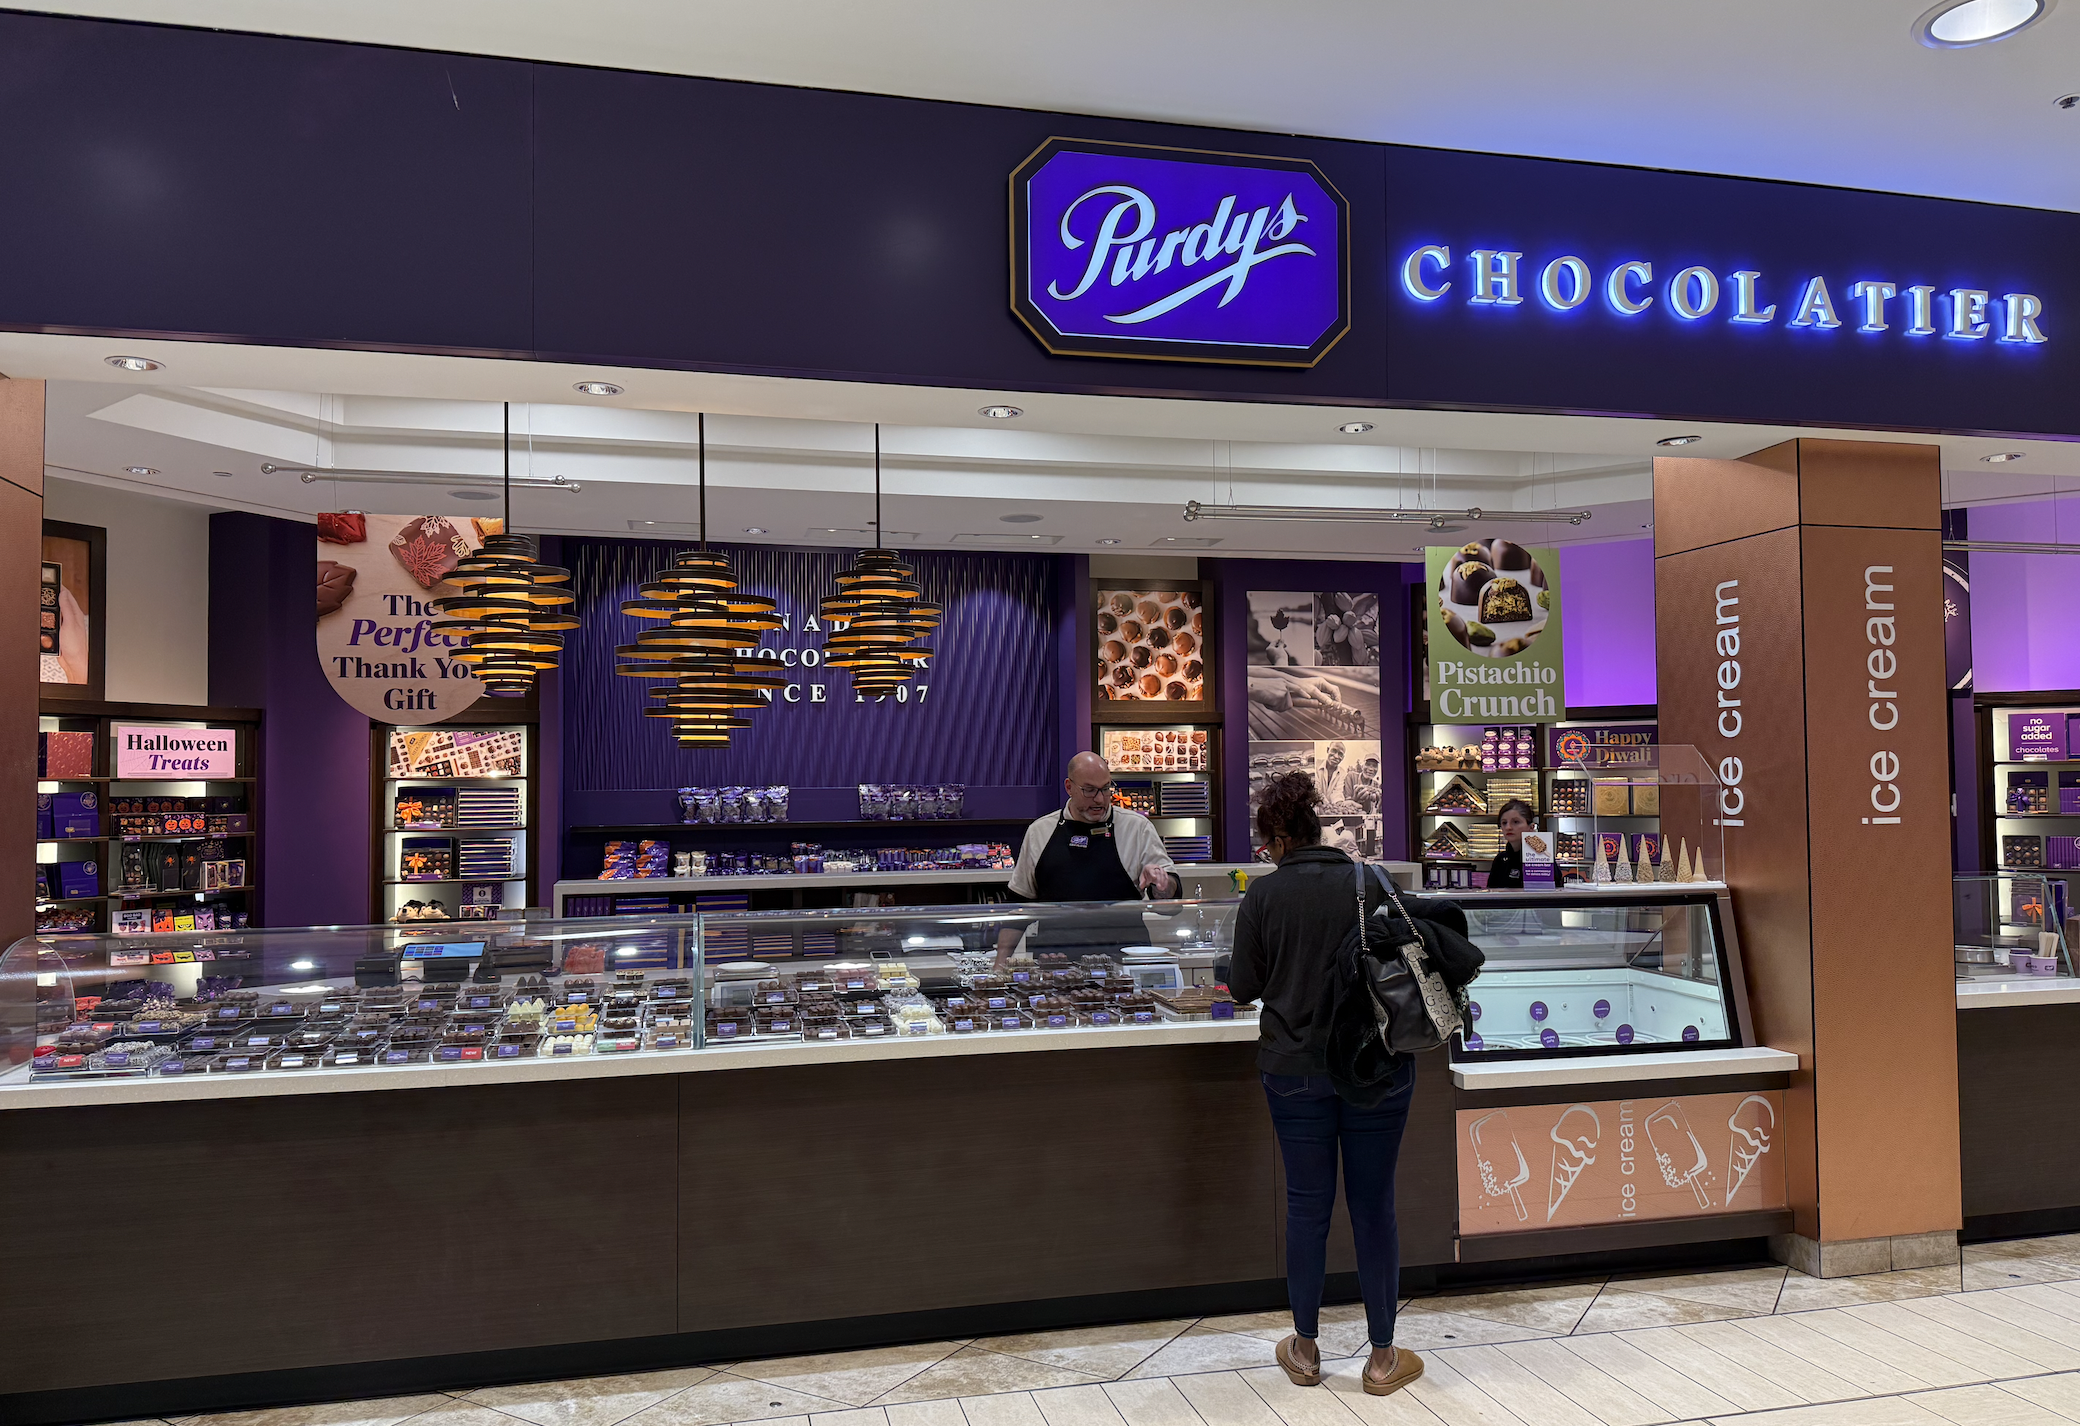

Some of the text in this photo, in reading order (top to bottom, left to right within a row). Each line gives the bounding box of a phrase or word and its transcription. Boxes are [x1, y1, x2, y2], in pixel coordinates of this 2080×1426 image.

[1047, 185, 1317, 324] Purdys
[1401, 244, 2049, 344] CHOCOLATIER
[383, 594, 440, 617] The
[332, 656, 480, 679] Thank Yo
[1437, 661, 1556, 685] Pistachio
[383, 687, 438, 710] Gift
[1439, 688, 1557, 718] Crunch
[1712, 579, 1745, 827] ice cream
[1861, 565, 1901, 825] ice cream
[1594, 730, 1652, 747] Happy
[2021, 732, 2052, 740] added
[2022, 725, 2050, 734] sugar
[127, 734, 228, 752] Halloween
[2015, 746, 2059, 754] chocolates
[149, 754, 210, 771] Treats
[1594, 747, 1651, 763] Diwali
[1618, 1101, 1636, 1217] ice cream
